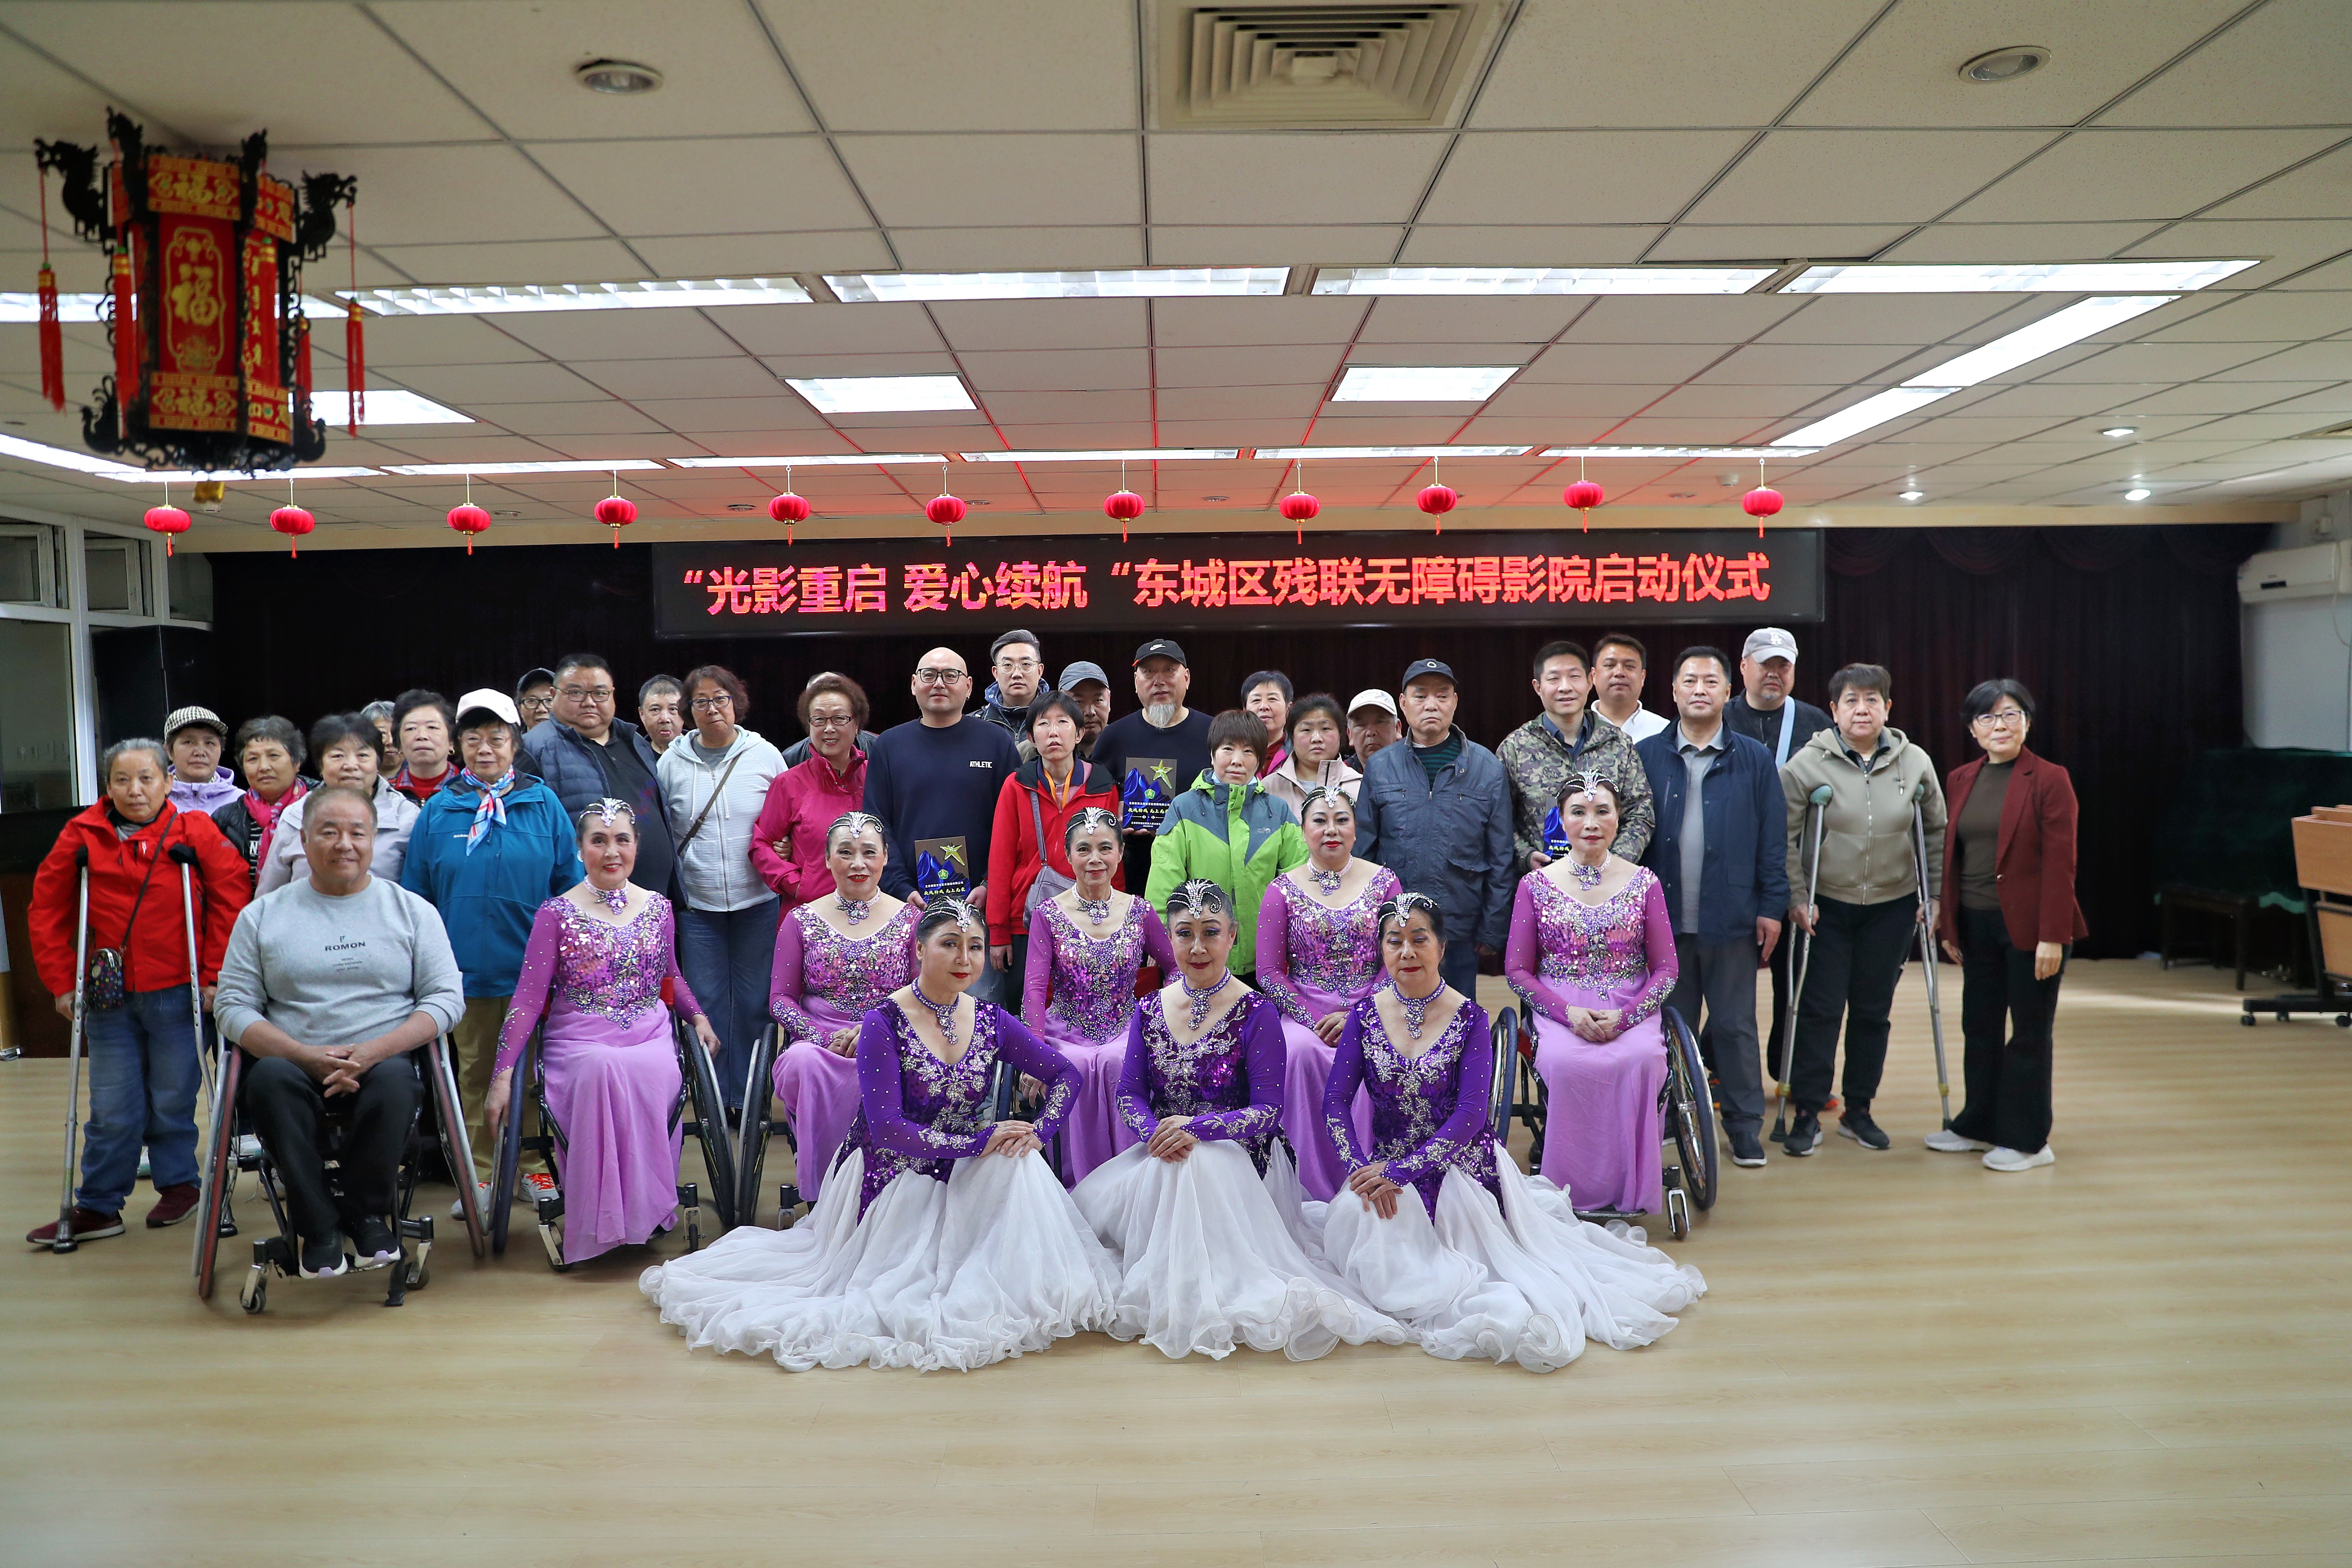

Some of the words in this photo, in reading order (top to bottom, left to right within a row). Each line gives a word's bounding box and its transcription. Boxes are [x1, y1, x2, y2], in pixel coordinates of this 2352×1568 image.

[171, 263, 218, 326] 福
[904, 560, 1087, 610] 爱心续航
[1770, 633, 1782, 644] LA
[325, 941, 366, 951] ROMON
